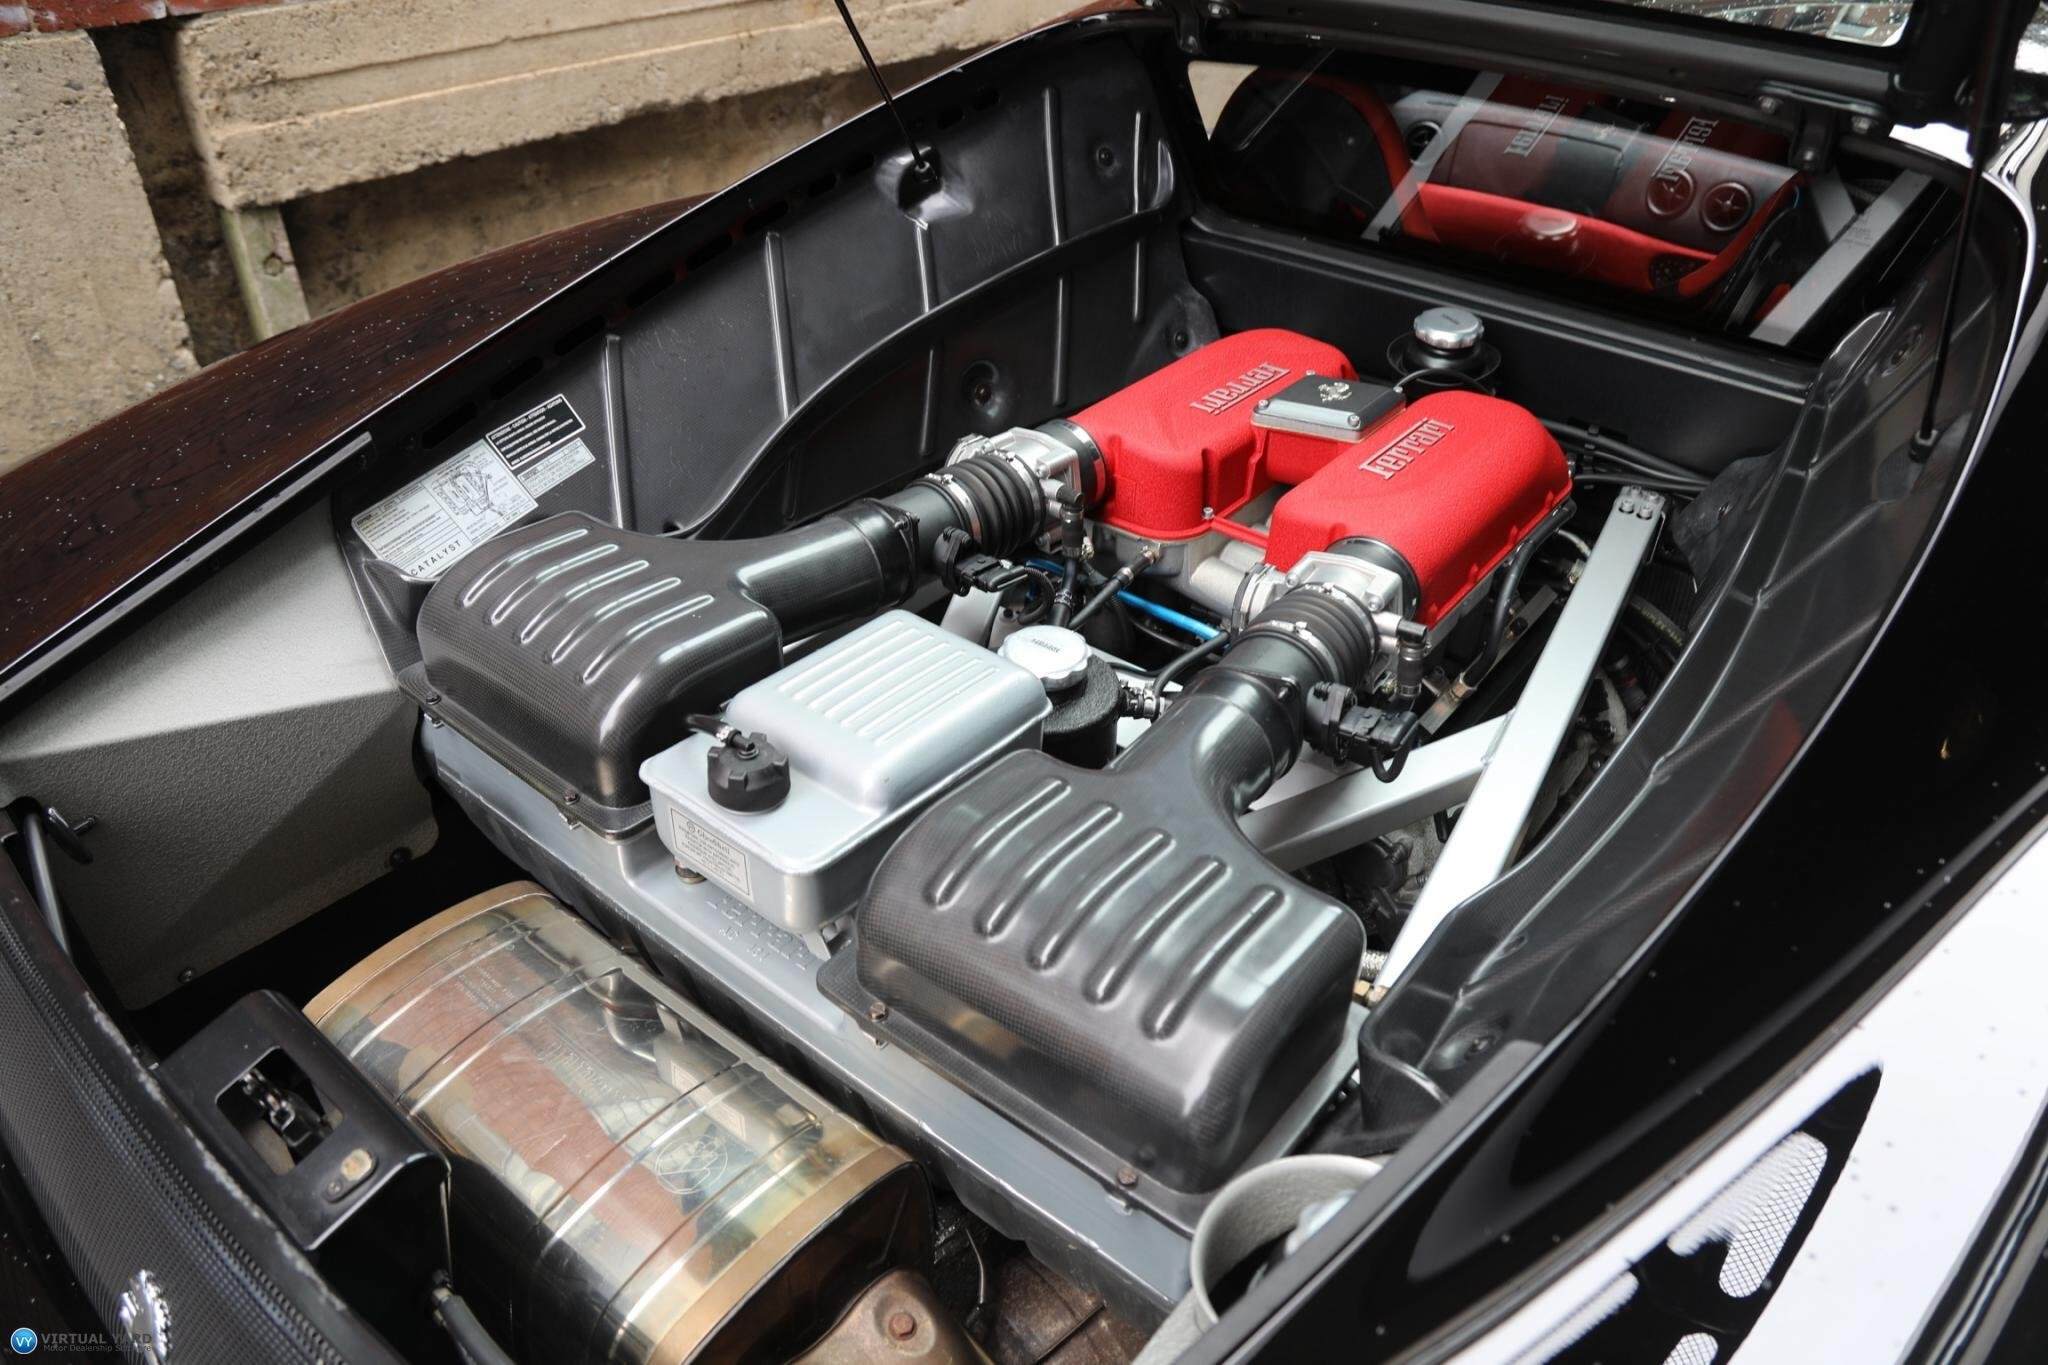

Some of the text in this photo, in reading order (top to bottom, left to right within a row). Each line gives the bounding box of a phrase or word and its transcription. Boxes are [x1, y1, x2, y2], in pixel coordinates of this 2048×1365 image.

[1189, 362, 1291, 416] Ferrari
[1359, 417, 1456, 480] Ferrari
[410, 540, 462, 576] CATALYST
